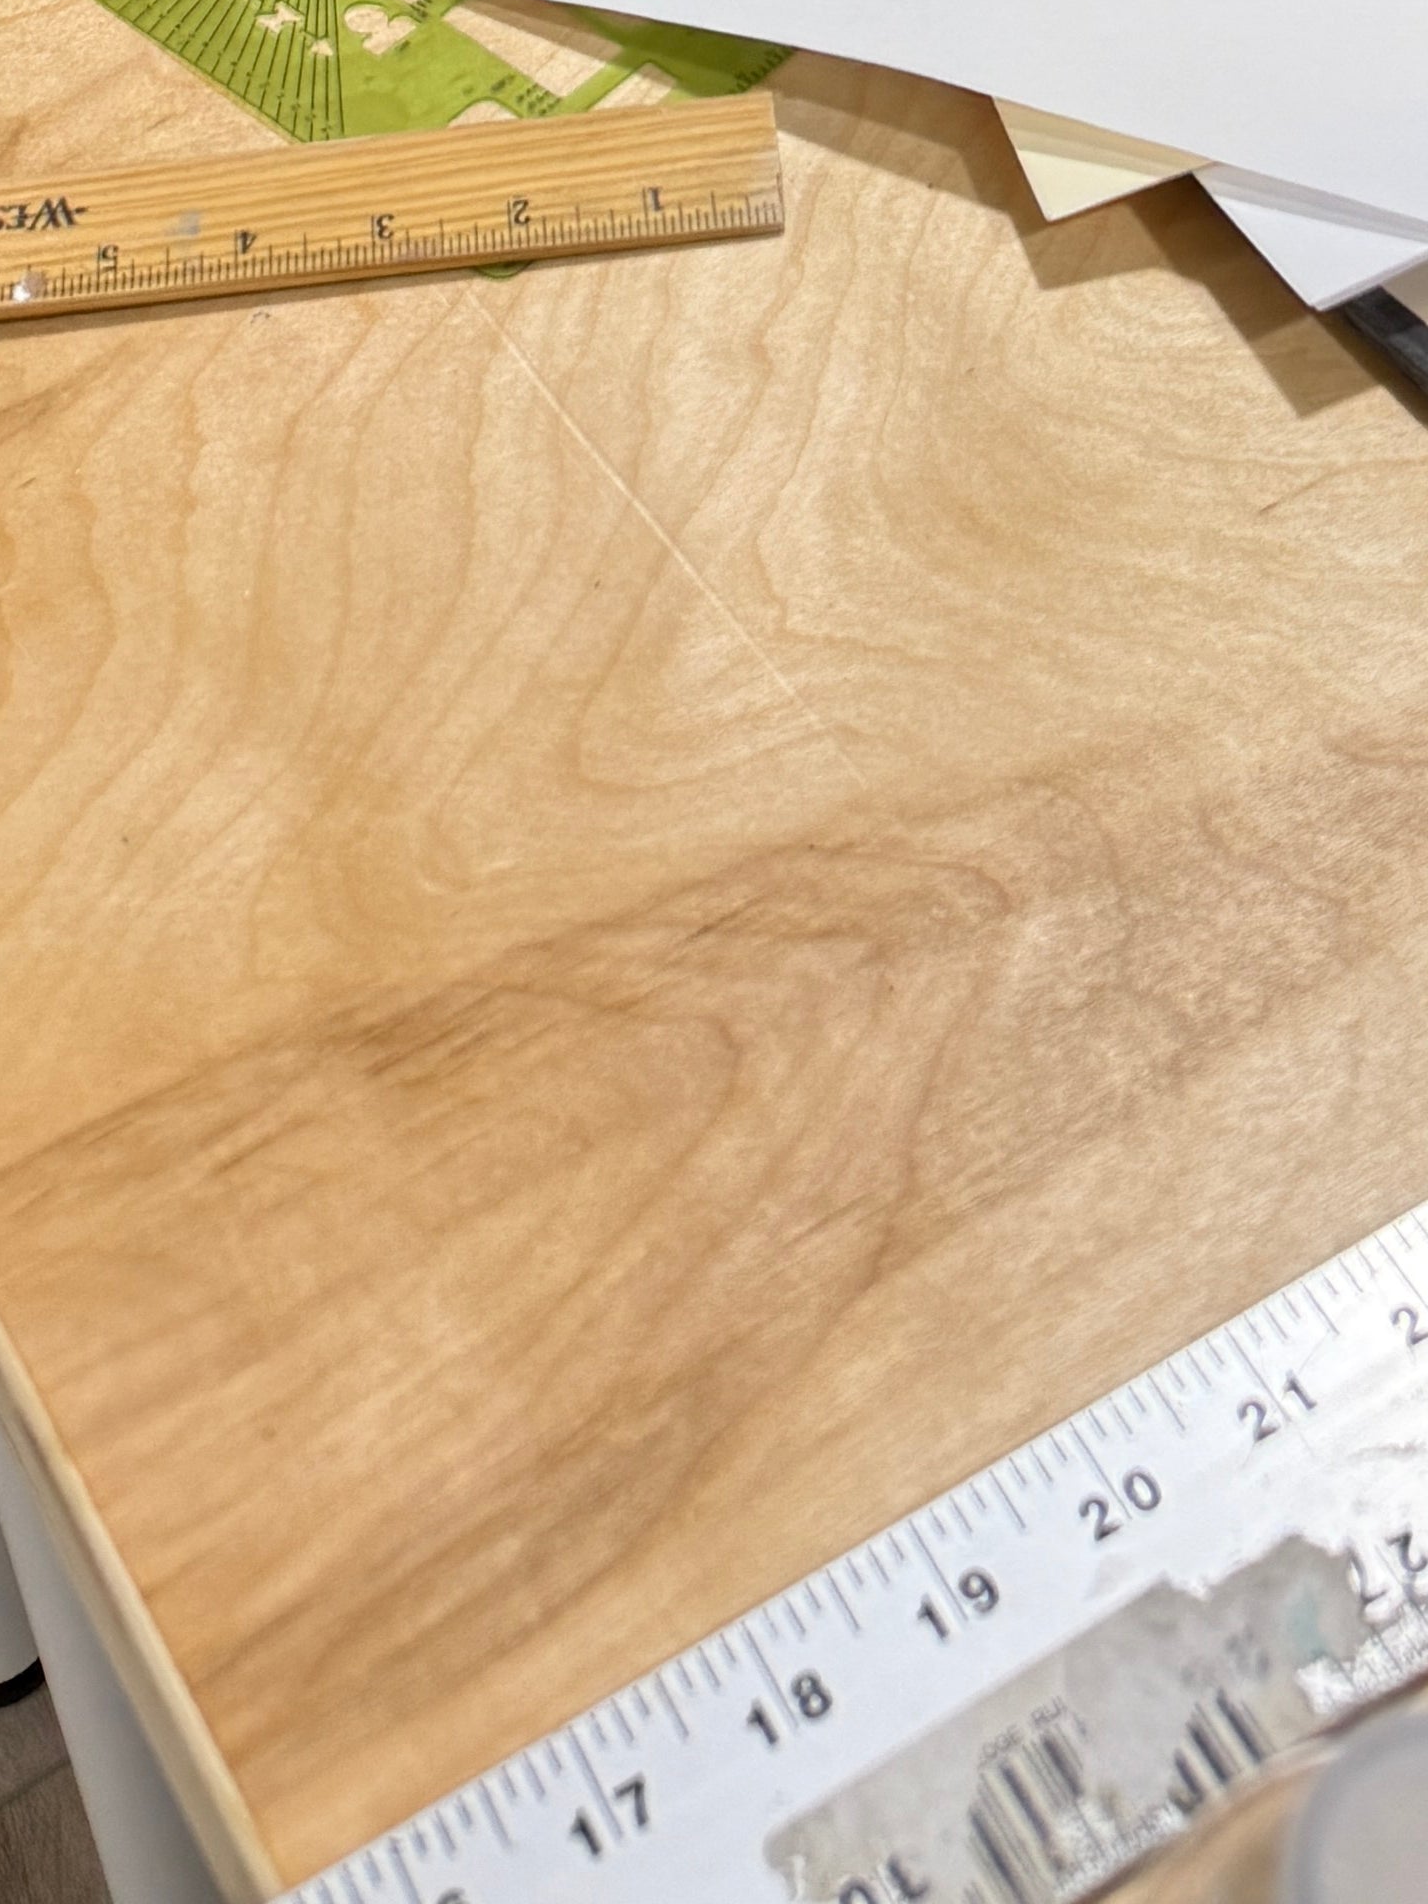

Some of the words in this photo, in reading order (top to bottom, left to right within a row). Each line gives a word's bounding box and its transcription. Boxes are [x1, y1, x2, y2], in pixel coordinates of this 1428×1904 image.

[567, 1770, 654, 1863] 17
[744, 1664, 837, 1750] 18
[915, 1566, 1002, 1644] 19
[1079, 1471, 1163, 1544] 20
[1234, 1376, 1320, 1444] 21
